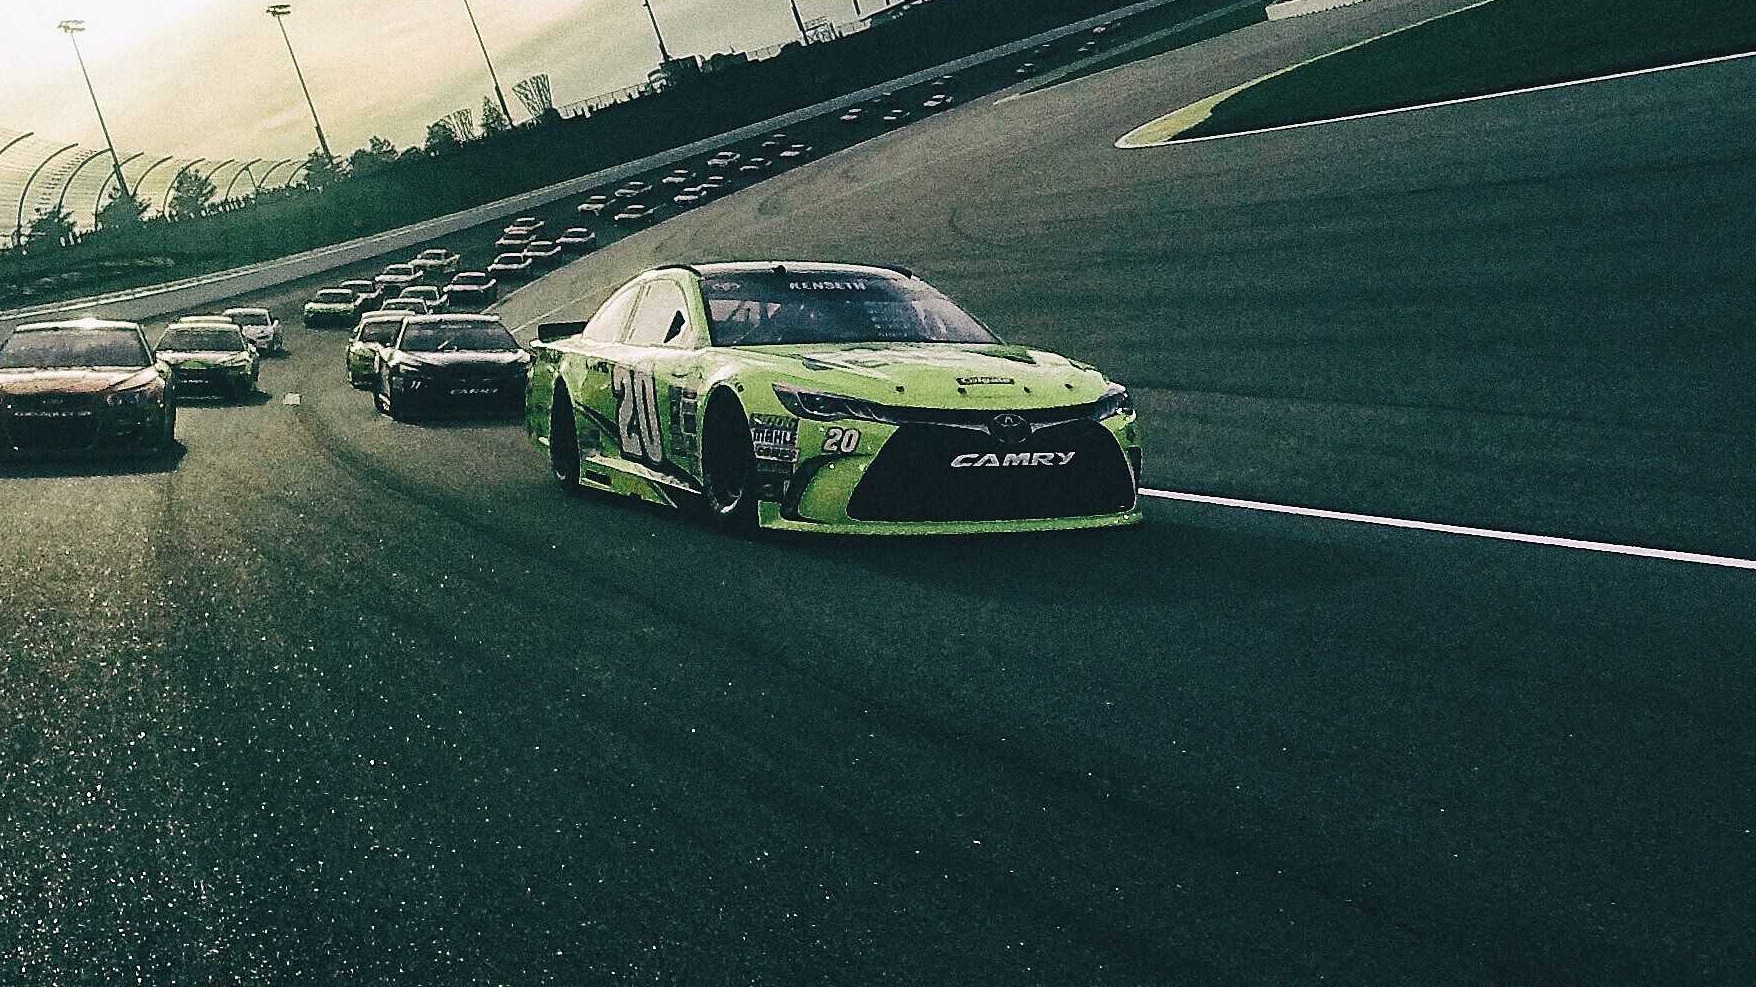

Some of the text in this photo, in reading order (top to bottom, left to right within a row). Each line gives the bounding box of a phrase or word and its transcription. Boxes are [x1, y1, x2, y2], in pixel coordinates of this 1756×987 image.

[789, 279, 868, 291] KENSETH
[614, 361, 663, 462] 20
[822, 426, 861, 453] 20
[950, 451, 1076, 468] CAMRY
